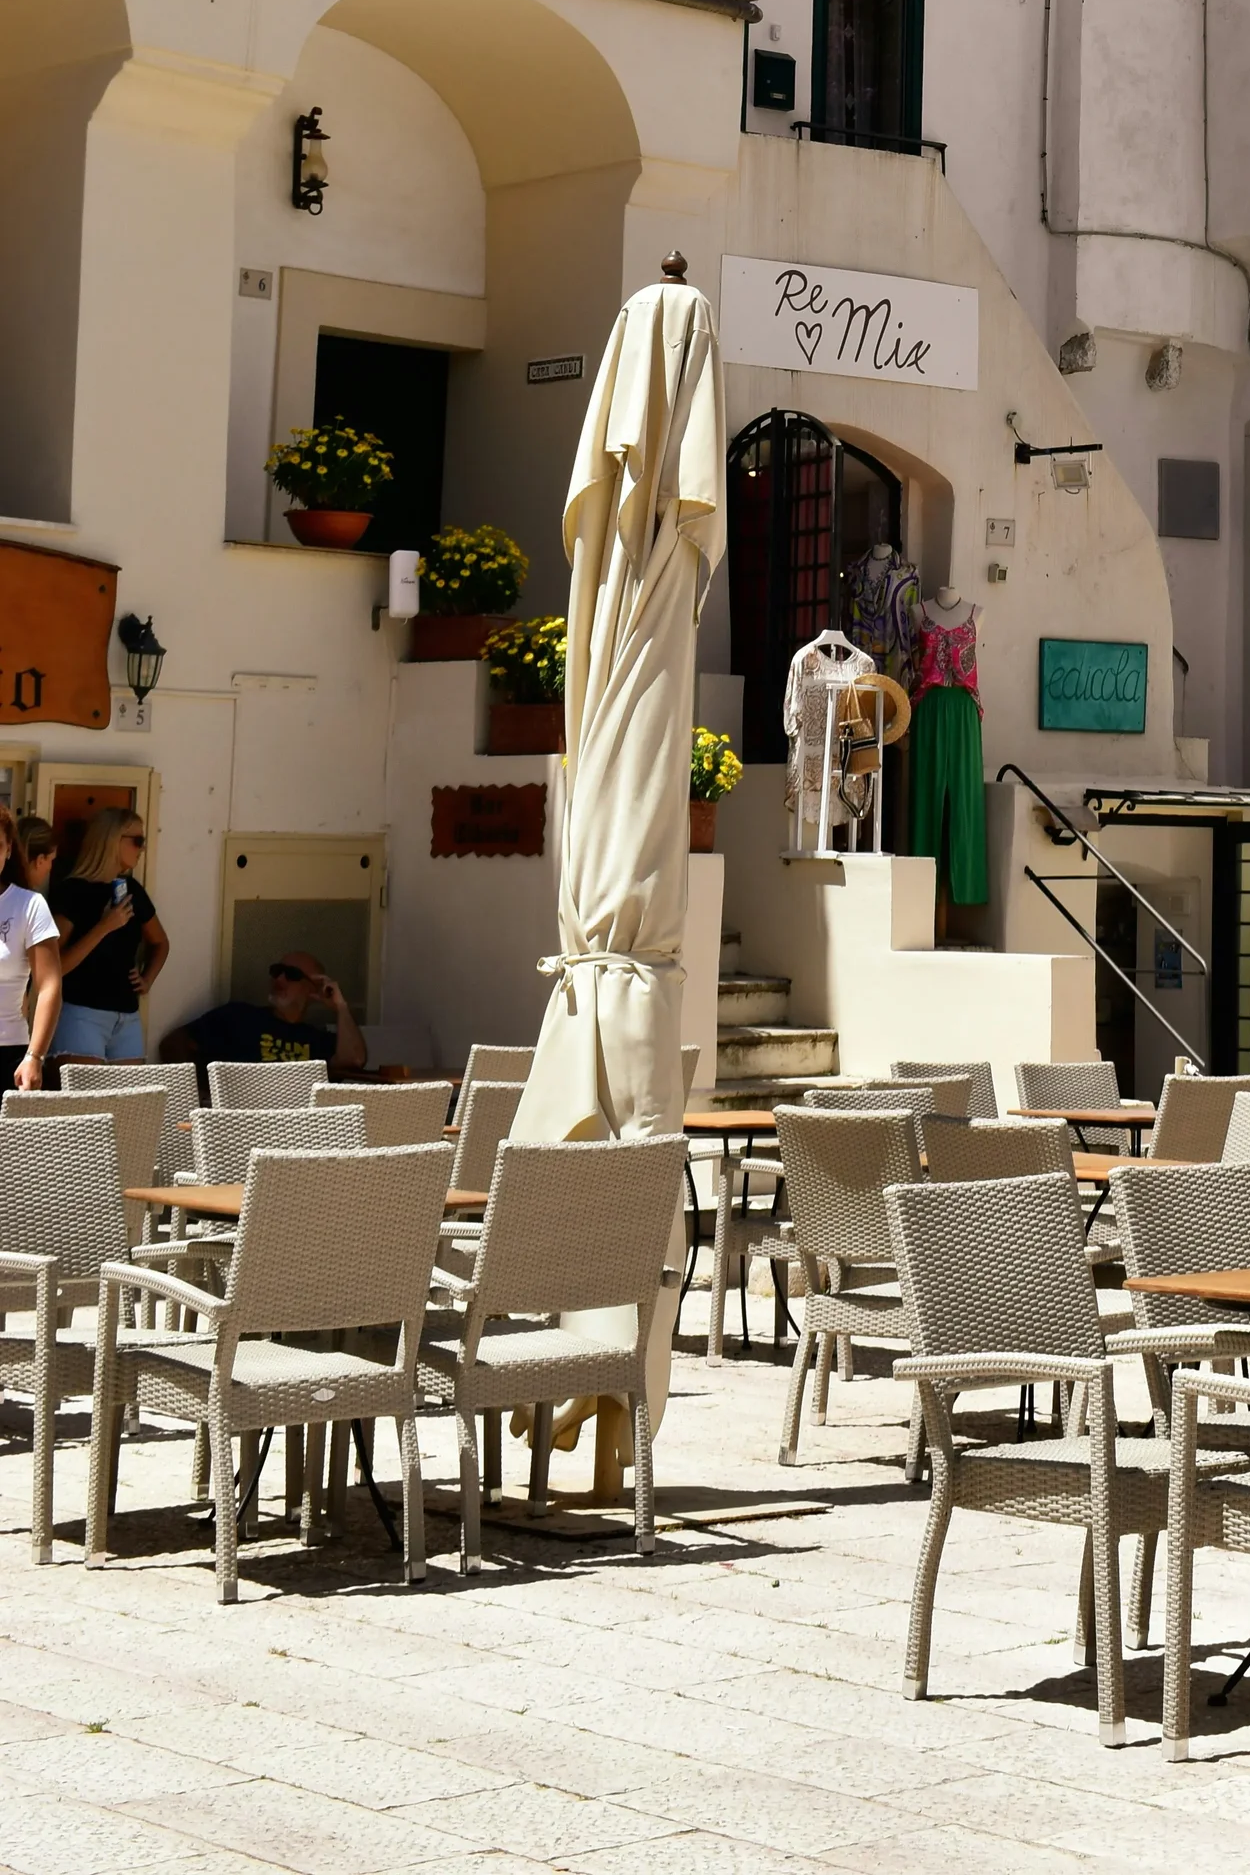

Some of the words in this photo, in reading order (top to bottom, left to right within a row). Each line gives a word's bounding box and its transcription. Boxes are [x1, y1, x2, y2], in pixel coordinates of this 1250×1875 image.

[258, 277, 266, 292] 6
[775, 269, 829, 317] Re
[832, 297, 931, 374] Mix
[1003, 526, 1010, 539] 7
[0, 665, 46, 713] o
[1046, 648, 1141, 702] edicola
[136, 709, 144, 725] 5
